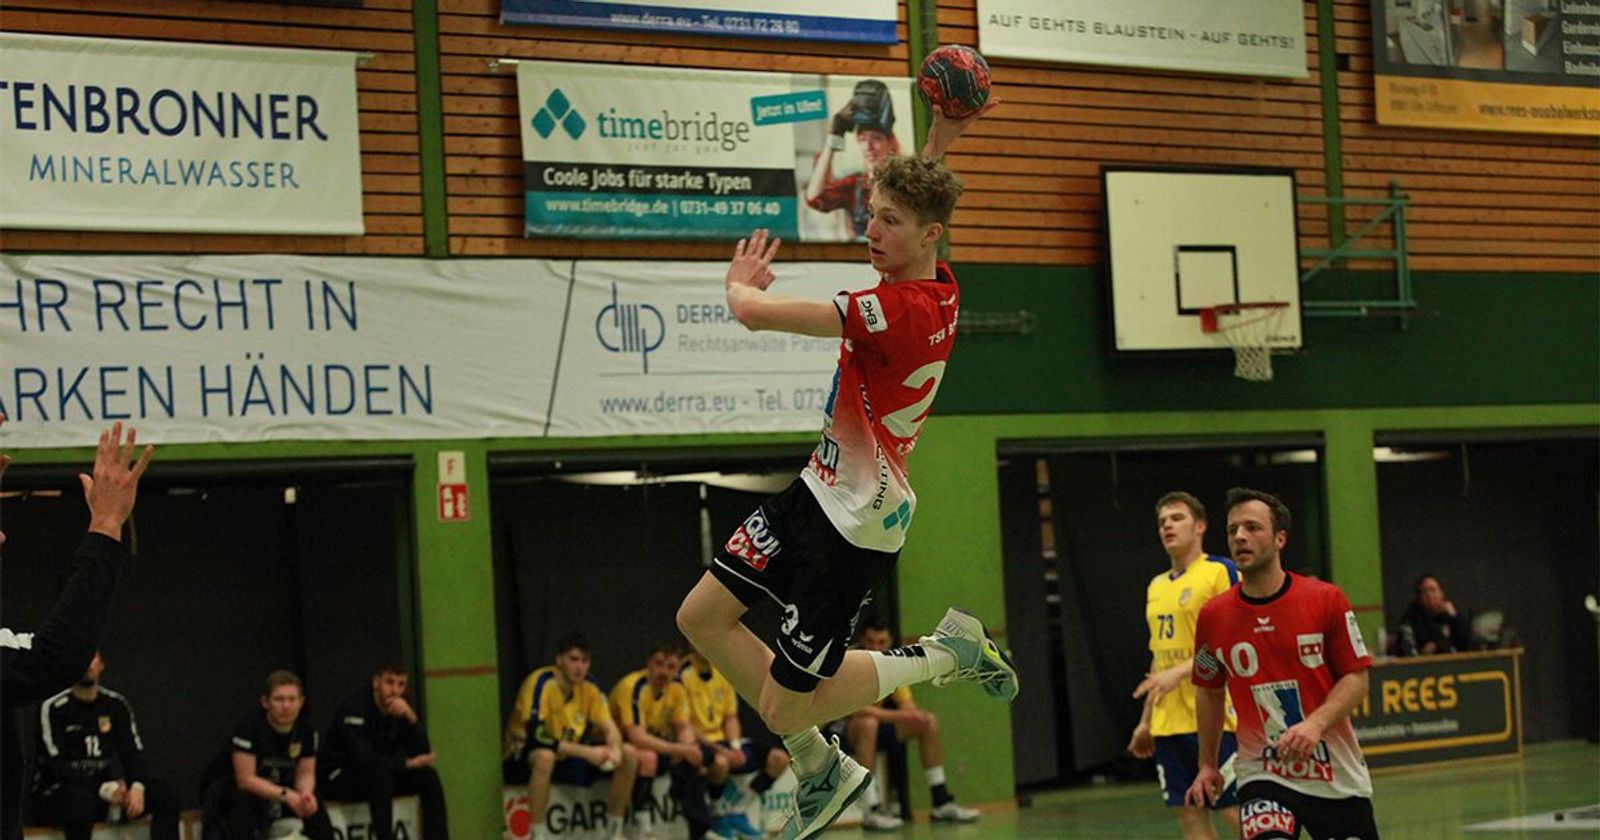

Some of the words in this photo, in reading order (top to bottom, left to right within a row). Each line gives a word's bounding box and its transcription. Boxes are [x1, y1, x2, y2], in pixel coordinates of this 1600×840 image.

[989, 14, 1021, 28] AUF
[1029, 17, 1086, 33] GEHTS
[1093, 22, 1185, 40] BLAUSTEIN
[1201, 31, 1231, 44] AUF
[1238, 33, 1295, 49] GEHTS!
[756, 104, 782, 121] Jetzt
[783, 102, 795, 115] in
[597, 108, 750, 151] timebridge
[29, 154, 300, 189] MINERALWASSER
[543, 168, 588, 186] Coole
[590, 169, 625, 190] Jobs
[628, 169, 653, 188] für
[656, 171, 704, 190] starke
[707, 172, 752, 195] Typen
[546, 199, 669, 217] www.timebridge.de
[730, 202, 745, 215] 37
[92, 279, 283, 332] RECHT
[304, 279, 358, 332] IN
[676, 304, 736, 324] DERRA
[861, 300, 878, 326] DHB
[200, 352, 433, 418] HÄNDEN
[599, 391, 736, 413] www.derra.eu
[755, 389, 788, 411] Tel.
[1157, 614, 1174, 640] 73
[1216, 642, 1259, 678] 10
[1381, 675, 1458, 715] REES
[84, 735, 102, 757] 12
[1266, 757, 1331, 781] MOLY
[1243, 813, 1294, 839] MOLY
